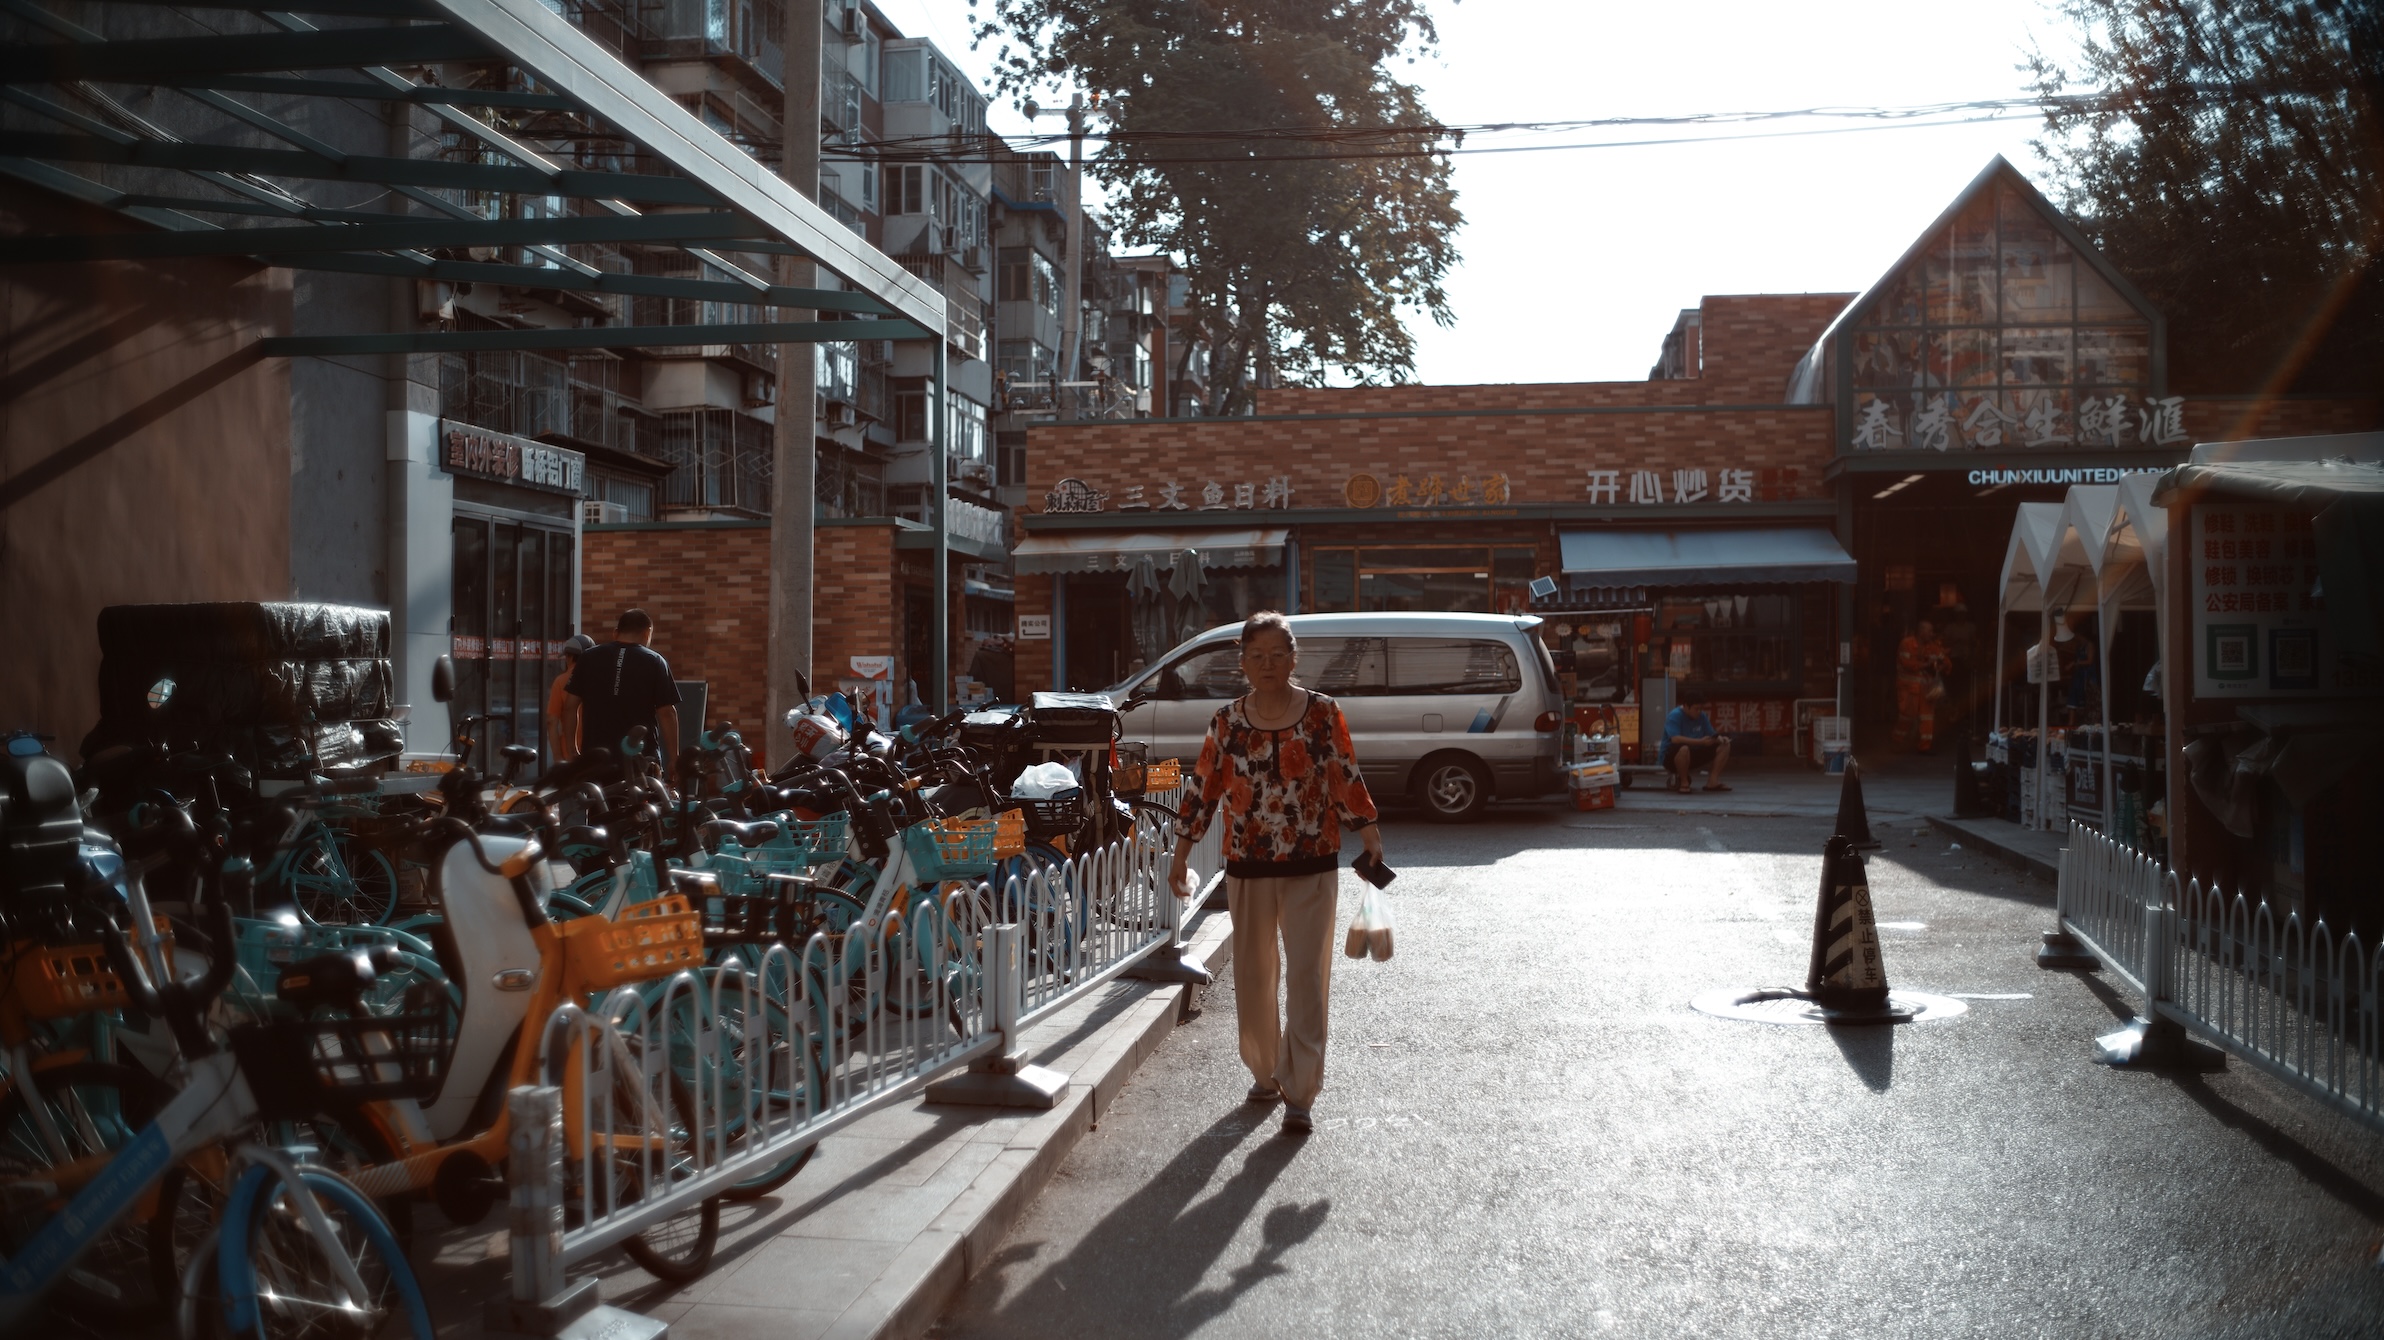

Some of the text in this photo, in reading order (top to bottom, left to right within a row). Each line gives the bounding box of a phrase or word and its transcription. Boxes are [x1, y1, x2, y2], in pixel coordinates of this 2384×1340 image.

[449, 429, 582, 491] 室内外装修 断桥铝门窗
[1118, 476, 1295, 511] 三文鱼日料
[1586, 468, 1753, 504] 开心炒货
[2204, 513, 2235, 533] 修鞋
[2244, 513, 2275, 533] 洗鞋
[2205, 540, 2271, 560] 鞋包美容
[2205, 566, 2237, 586] 修锁
[2247, 566, 2295, 586] 换锁芯
[2206, 592, 2289, 612] 公安局备案
[1021, 619, 1047, 627] 公司
[1857, 908, 1877, 983] 禁止停车
